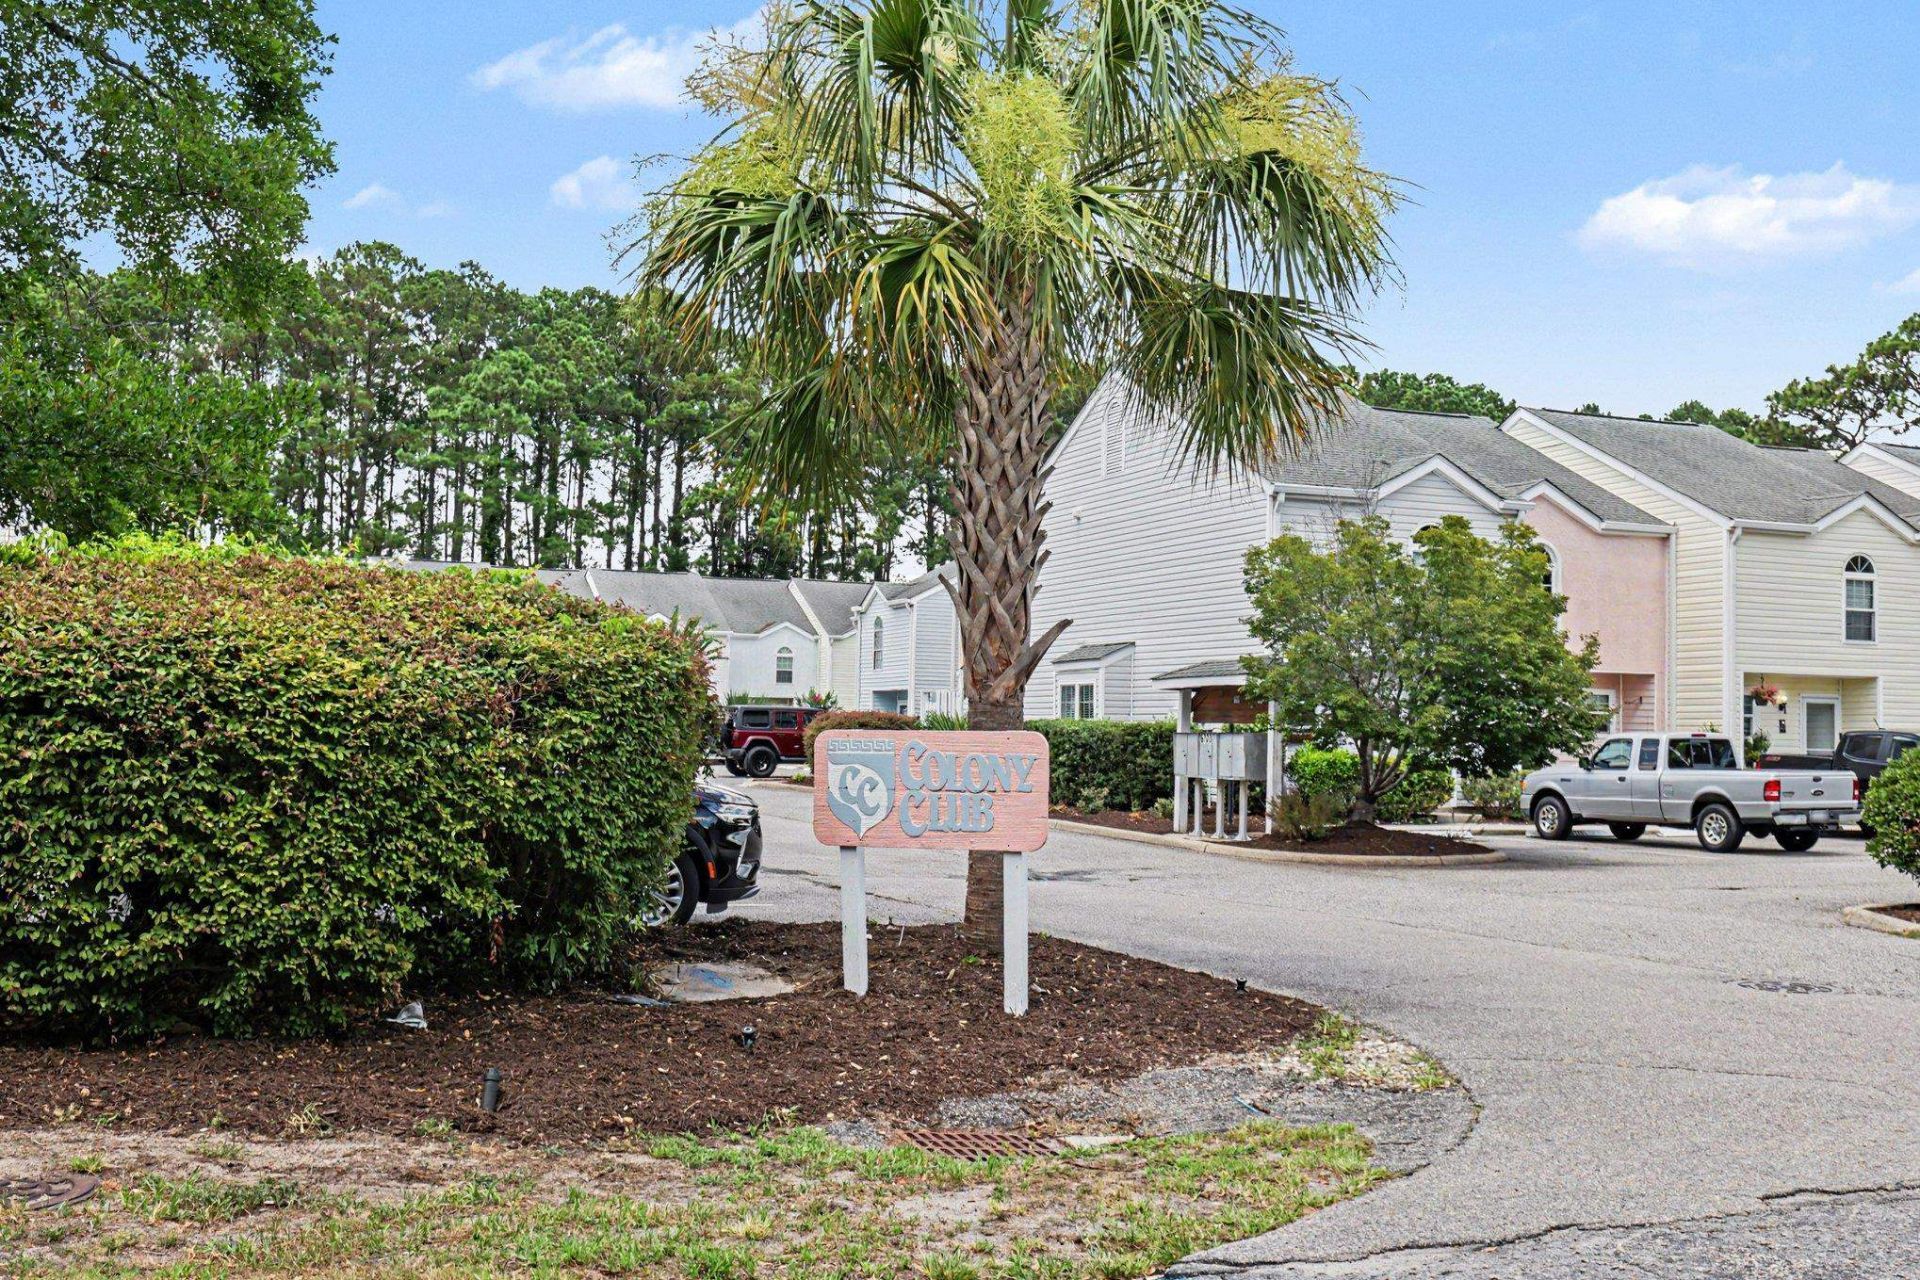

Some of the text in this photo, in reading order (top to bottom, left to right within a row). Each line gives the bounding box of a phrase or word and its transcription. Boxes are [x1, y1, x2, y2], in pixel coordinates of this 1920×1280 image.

[839, 766, 879, 816] CC
[901, 740, 1037, 793] COLONY
[900, 790, 994, 837] CLUB
